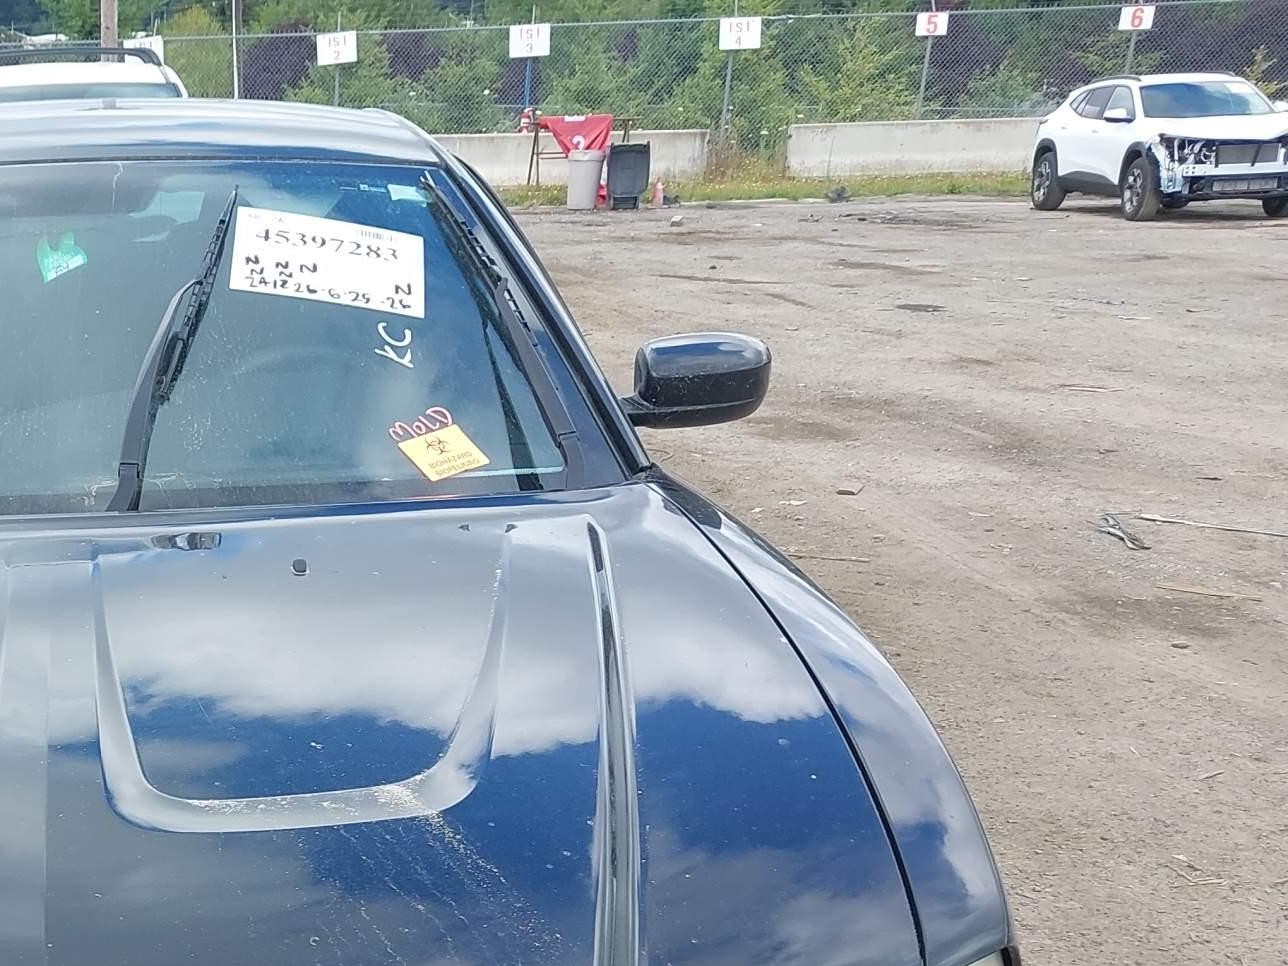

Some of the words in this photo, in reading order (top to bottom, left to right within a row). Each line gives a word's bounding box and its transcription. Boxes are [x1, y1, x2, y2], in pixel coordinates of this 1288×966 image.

[925, 14, 939, 34] 5
[1130, 7, 1144, 28] 6
[255, 228, 398, 261] 45397283
